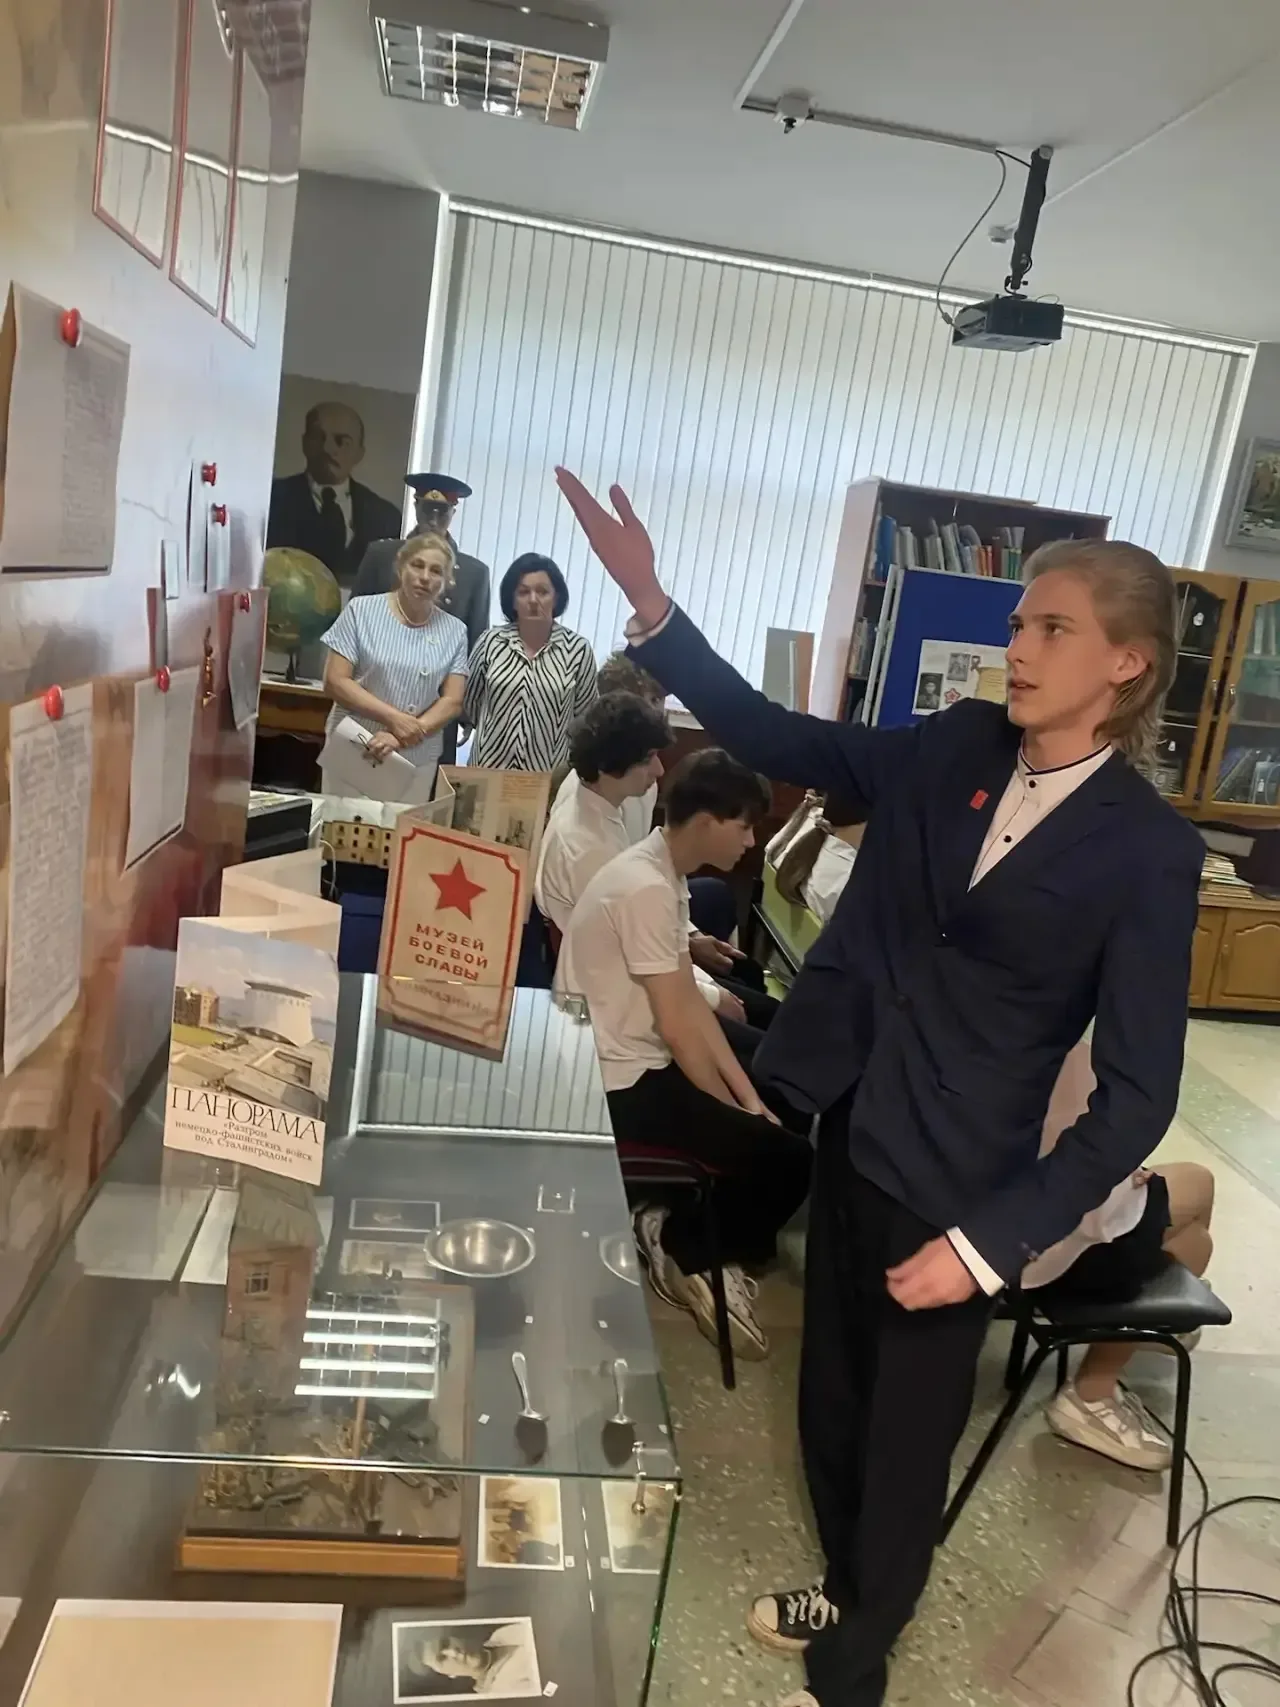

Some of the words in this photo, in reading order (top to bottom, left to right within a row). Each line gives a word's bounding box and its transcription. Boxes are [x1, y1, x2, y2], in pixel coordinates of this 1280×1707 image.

[416, 923, 484, 952] МУЗЕЙ
[409, 936, 488, 969] БОЕВОЙ
[415, 953, 479, 981] СЛАВЫ
[172, 1087, 320, 1145] ПАНОРАМА
[195, 1134, 213, 1145] под
